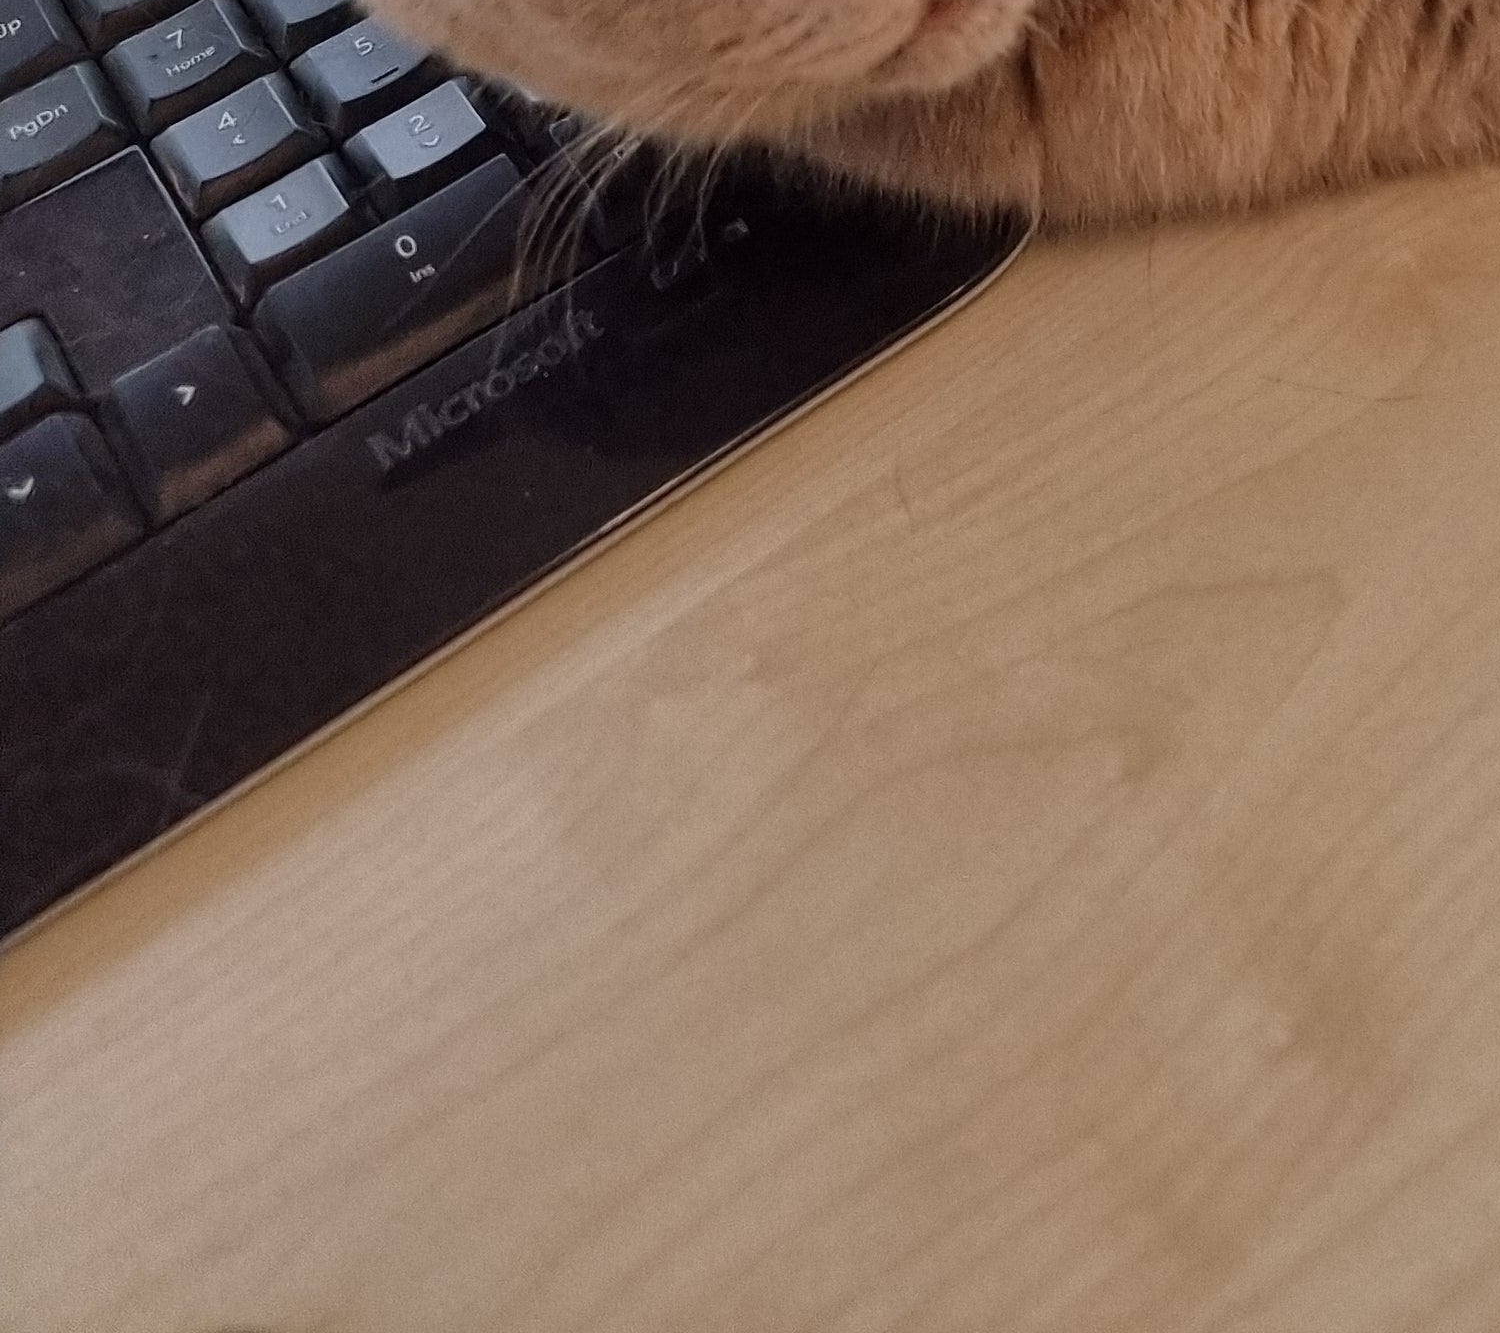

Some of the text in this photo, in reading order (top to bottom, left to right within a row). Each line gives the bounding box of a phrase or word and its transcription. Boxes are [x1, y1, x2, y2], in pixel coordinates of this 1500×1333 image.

[165, 29, 184, 50] 7
[354, 36, 374, 56] 5
[165, 45, 216, 77] Home
[9, 102, 69, 140] PgDn
[217, 110, 237, 132] 4
[408, 113, 432, 136] 2
[270, 193, 288, 210] 1
[394, 234, 418, 259] 0
[409, 263, 436, 283] Ins
[365, 308, 605, 471] Microsoft
